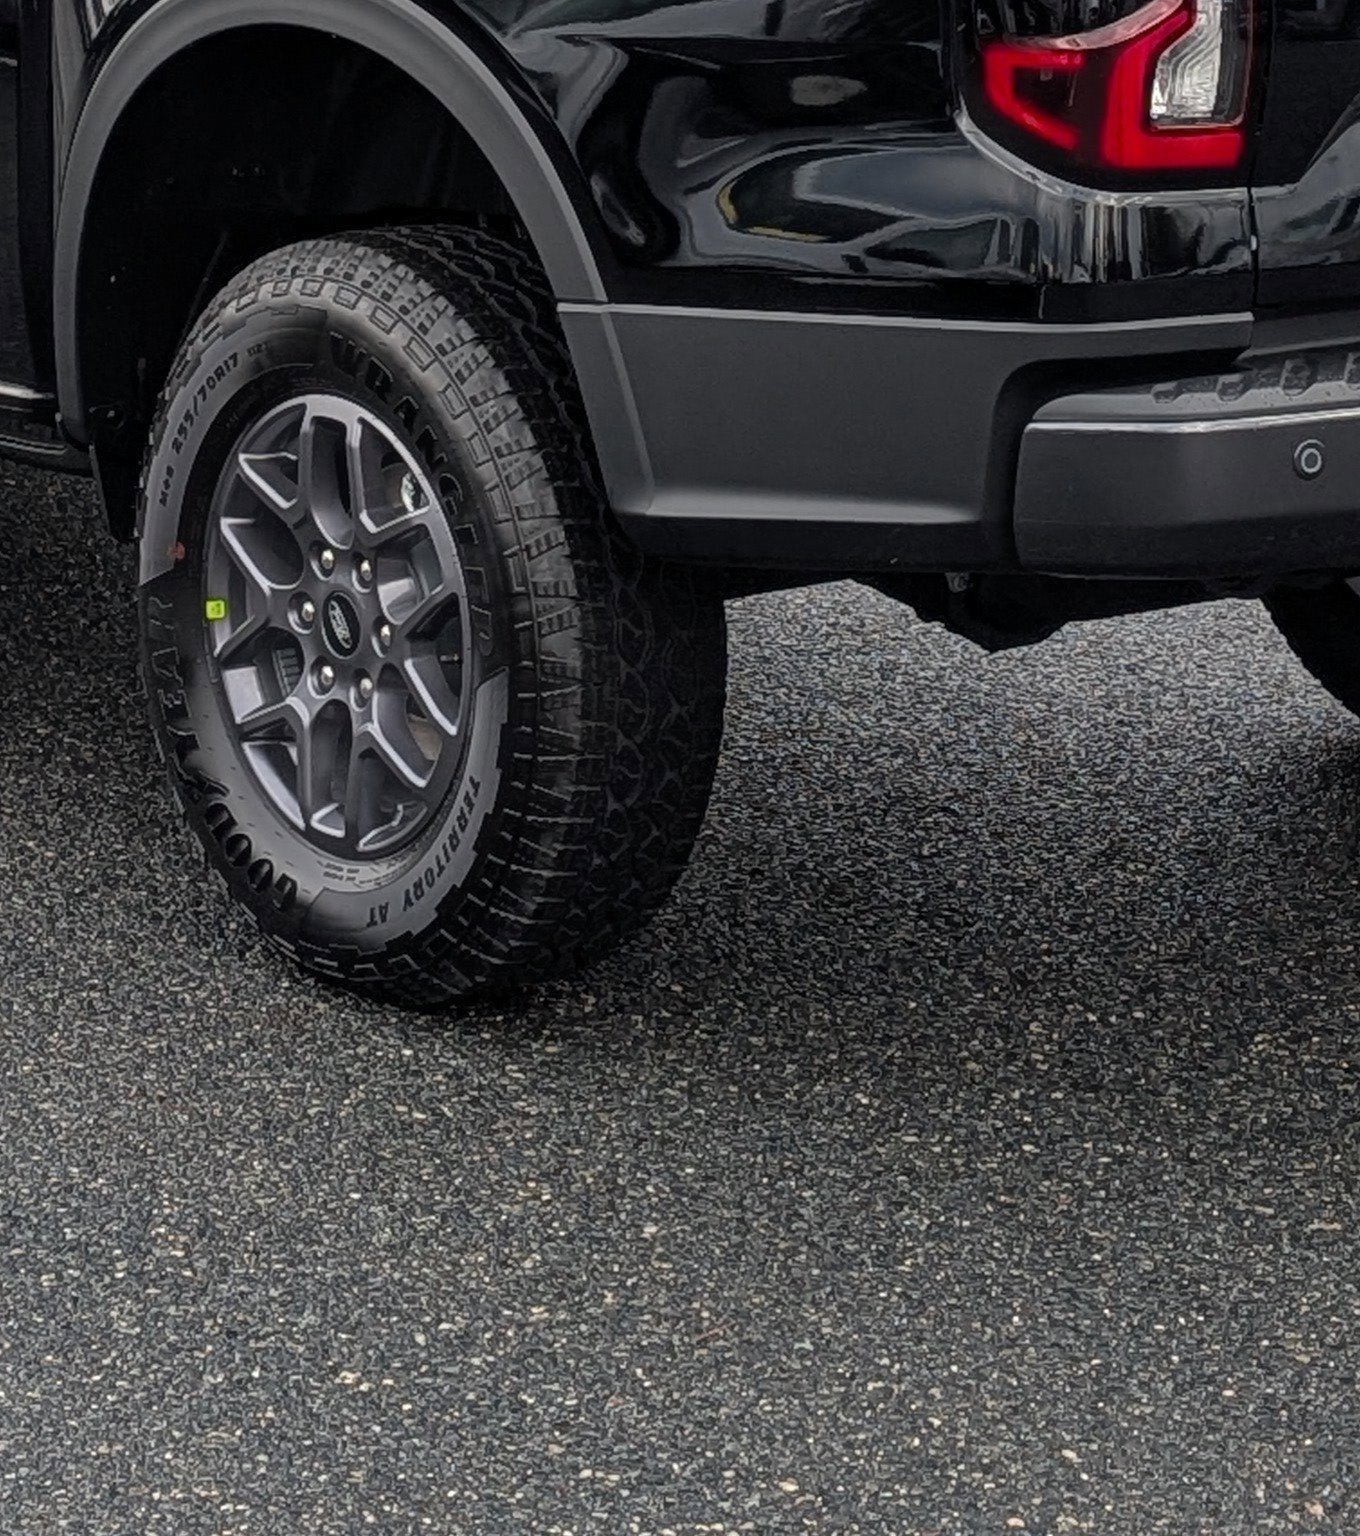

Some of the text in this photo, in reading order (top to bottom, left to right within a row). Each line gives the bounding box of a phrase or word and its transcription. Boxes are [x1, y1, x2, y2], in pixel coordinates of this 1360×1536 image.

[171, 351, 240, 456] 255/70R17
[365, 775, 481, 929] TERRITORY AT
